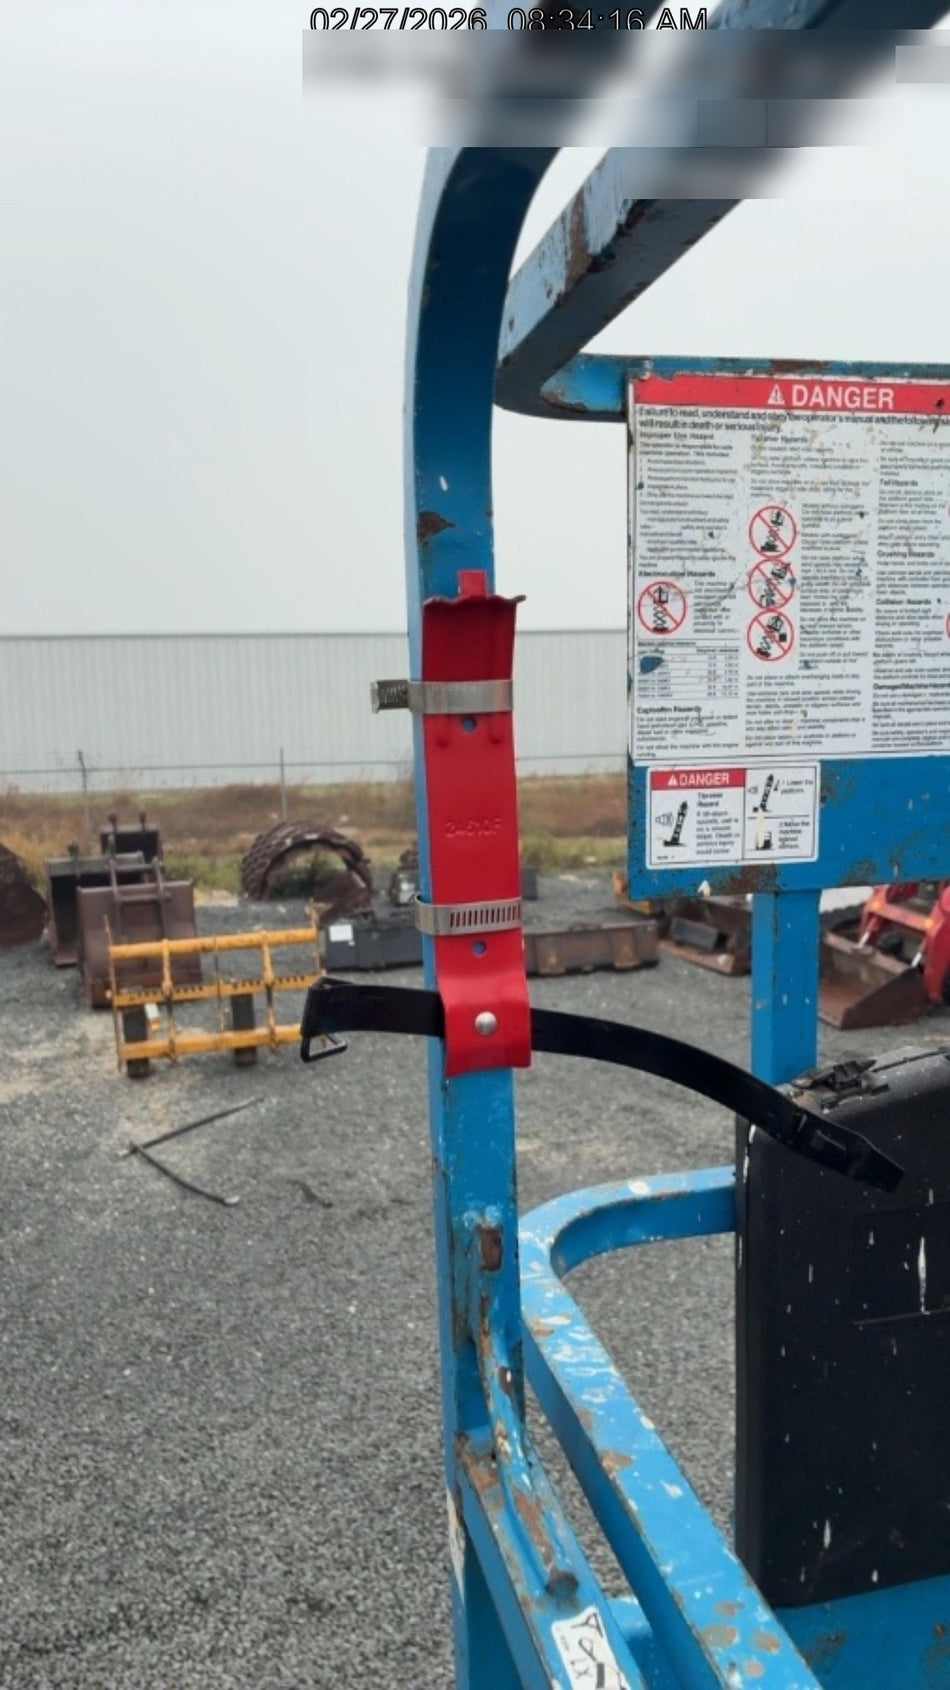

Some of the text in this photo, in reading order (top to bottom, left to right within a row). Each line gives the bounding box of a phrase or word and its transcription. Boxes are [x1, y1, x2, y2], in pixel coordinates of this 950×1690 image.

[791, 384, 895, 410] DANGER
[702, 411, 750, 419] understand
[680, 773, 730, 786] DANGER
